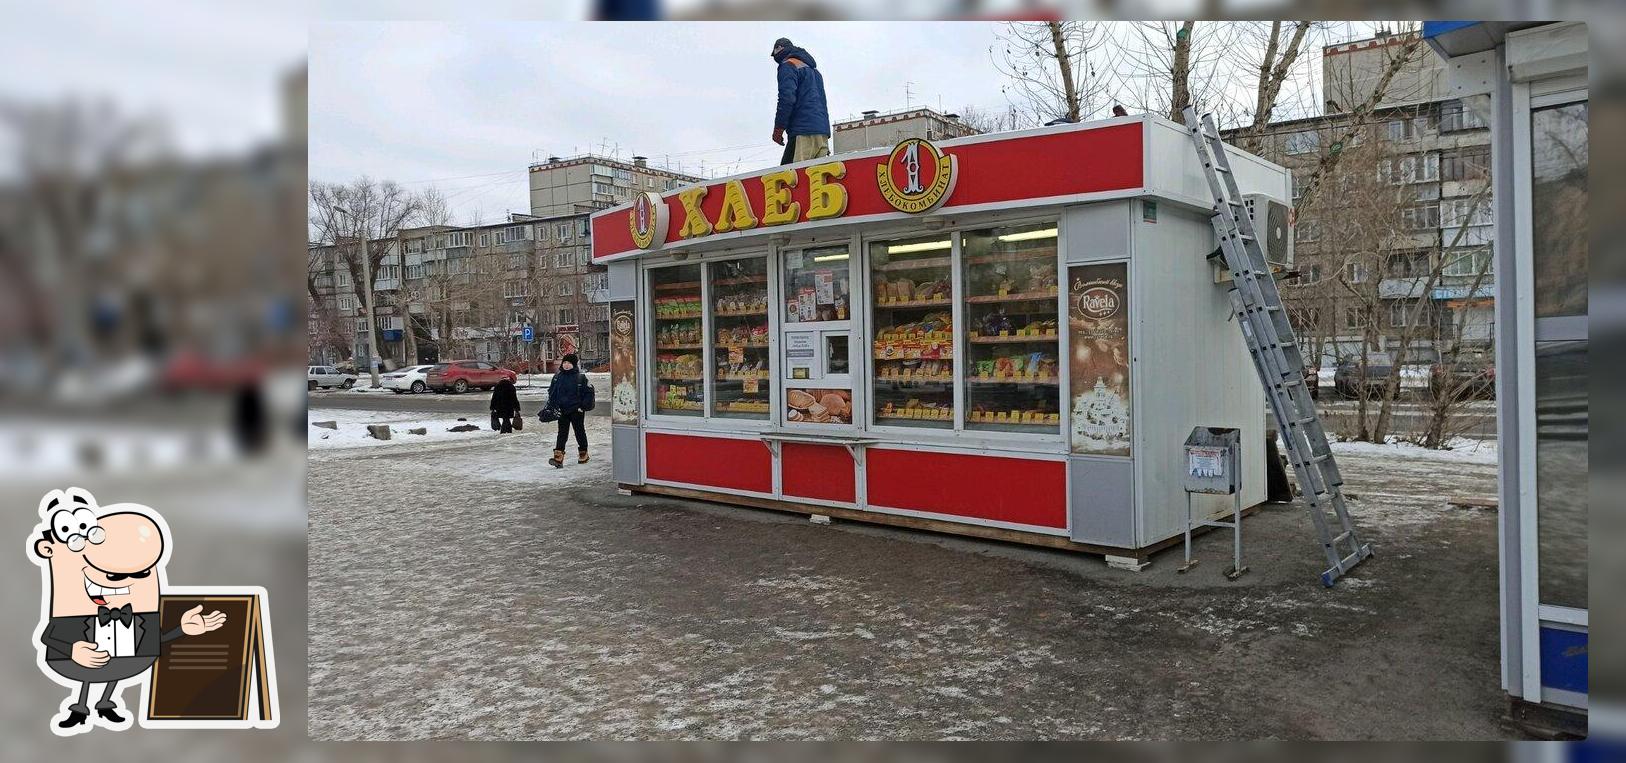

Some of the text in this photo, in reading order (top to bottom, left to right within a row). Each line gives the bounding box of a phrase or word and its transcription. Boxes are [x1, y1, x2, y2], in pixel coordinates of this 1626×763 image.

[878, 164, 950, 210] ХЛЕБОКОМБИНАТ
[901, 142, 924, 195] 1
[678, 161, 849, 238] ХЛЕБ
[1083, 294, 1115, 312] Ravela
[524, 328, 531, 339] P
